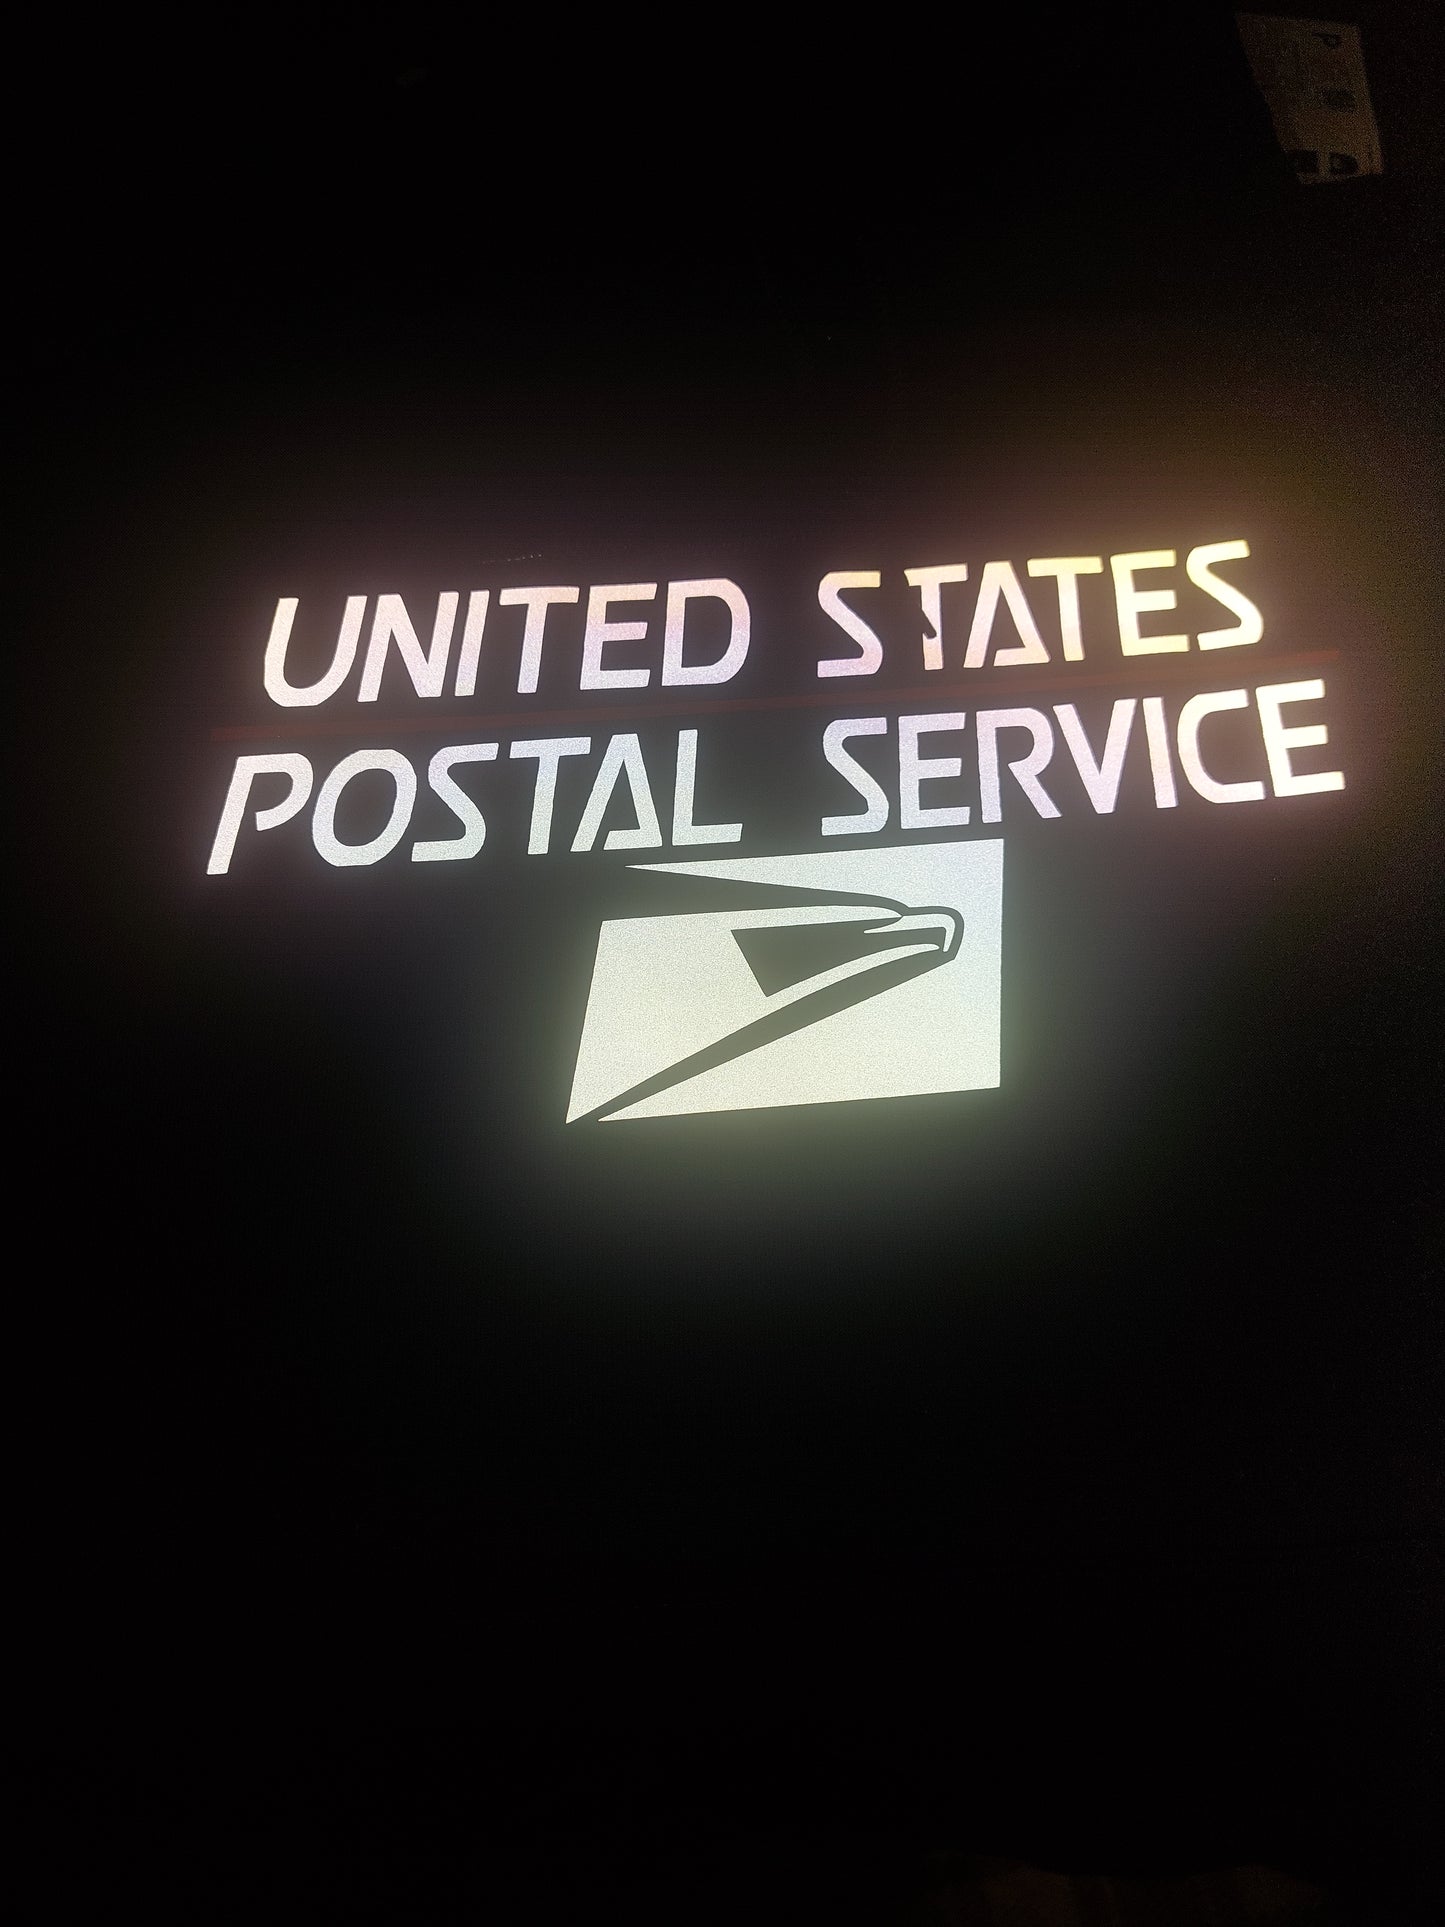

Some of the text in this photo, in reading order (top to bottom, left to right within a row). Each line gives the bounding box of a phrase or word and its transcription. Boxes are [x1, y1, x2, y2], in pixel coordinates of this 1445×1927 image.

[263, 539, 1265, 708] UNITED STATES
[206, 678, 1347, 876] POSTAL SERVICE
